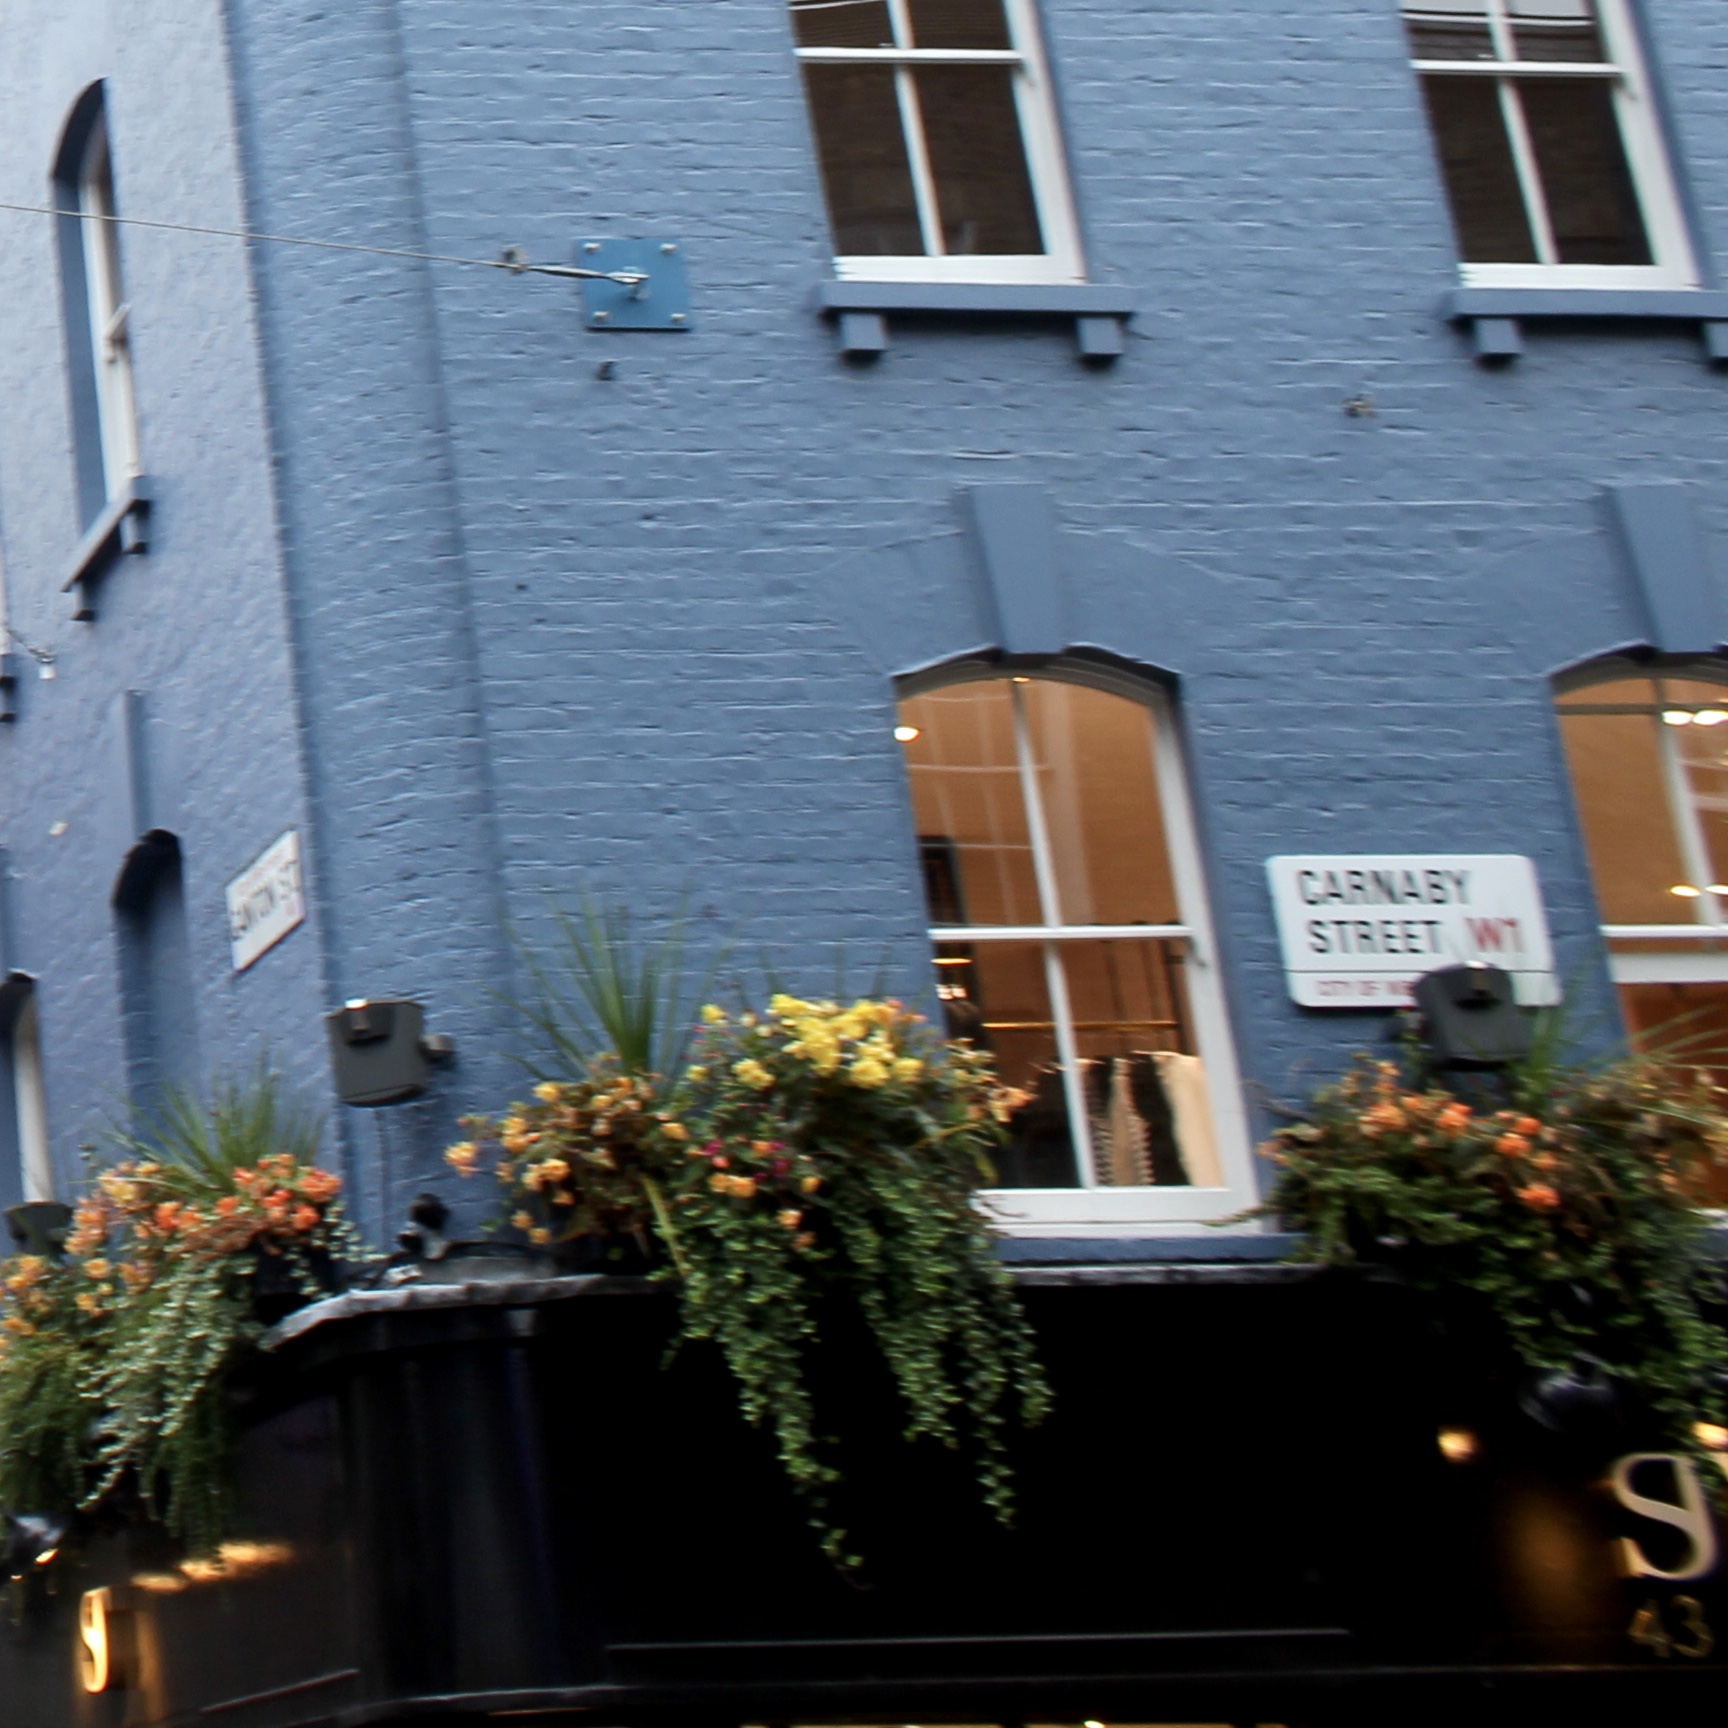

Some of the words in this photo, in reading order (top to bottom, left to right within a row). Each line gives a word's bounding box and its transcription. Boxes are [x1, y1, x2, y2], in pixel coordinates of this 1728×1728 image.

[1297, 869, 1471, 906] CARNABY
[1307, 919, 1443, 955] STREET
[1464, 917, 1525, 954] W1
[1627, 1595, 1714, 1658] 43
